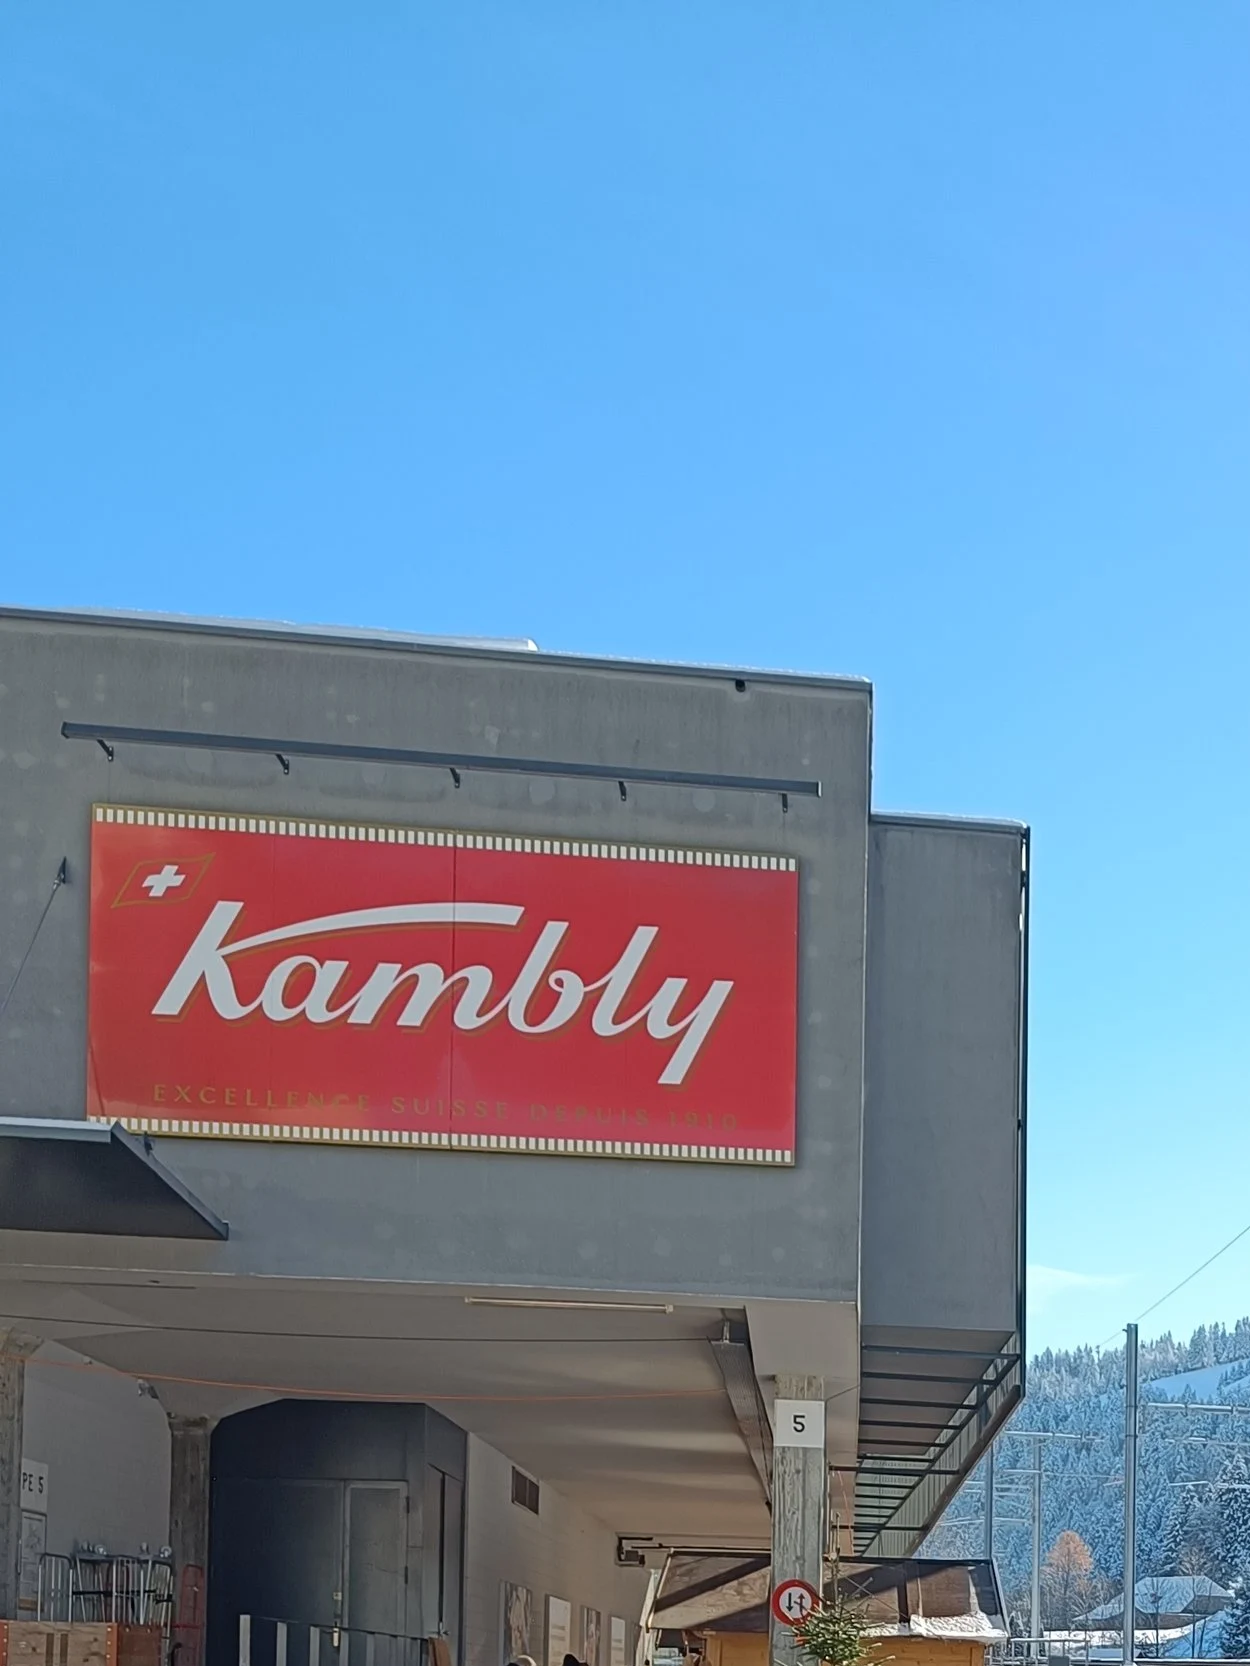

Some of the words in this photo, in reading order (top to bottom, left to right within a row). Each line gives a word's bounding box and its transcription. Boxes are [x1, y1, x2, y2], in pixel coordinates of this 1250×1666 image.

[152, 901, 733, 1085] Kambly
[154, 1084, 370, 1112] EXCELLENCE
[391, 1097, 509, 1121] SUISSE
[529, 1103, 649, 1128] DEPUIS
[668, 1111, 738, 1132] 1910
[792, 1415, 806, 1433] 5
[38, 1476, 44, 1494] 5
